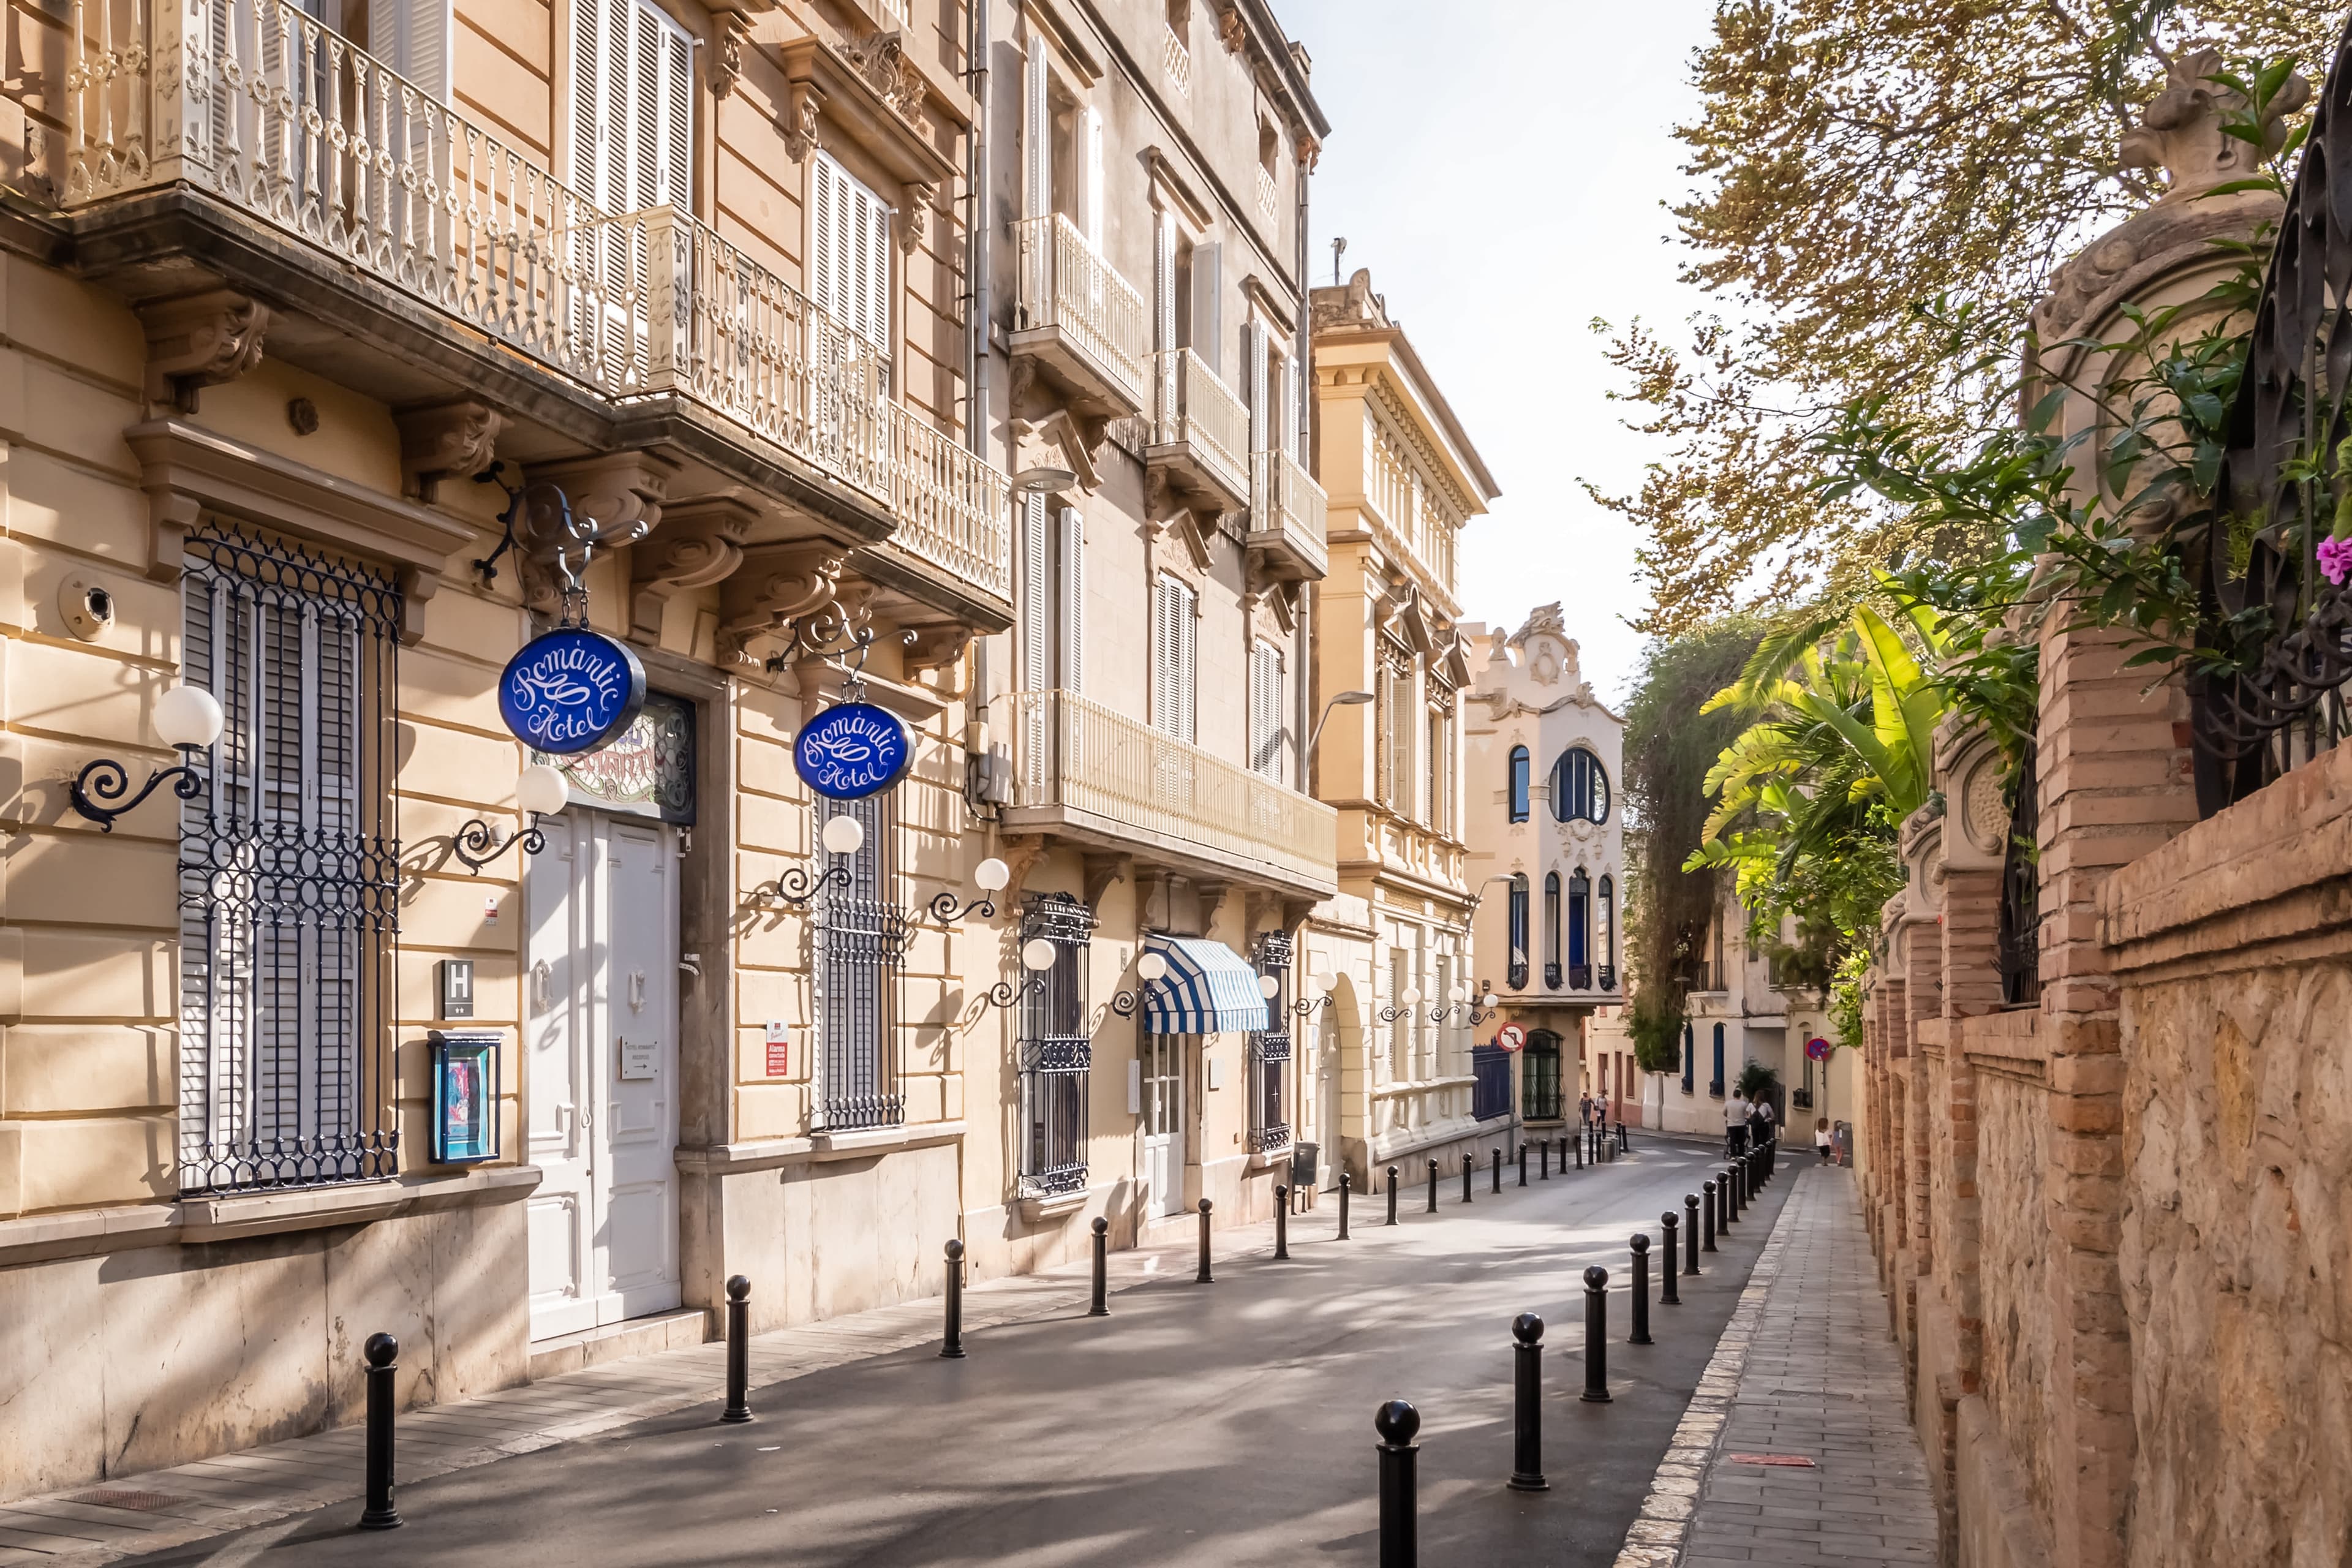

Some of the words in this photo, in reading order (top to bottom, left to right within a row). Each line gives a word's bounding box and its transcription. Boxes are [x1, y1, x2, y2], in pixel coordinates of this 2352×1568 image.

[528, 704, 609, 741] Hotel
[818, 762, 888, 790] Hotel
[451, 964, 468, 998] H
